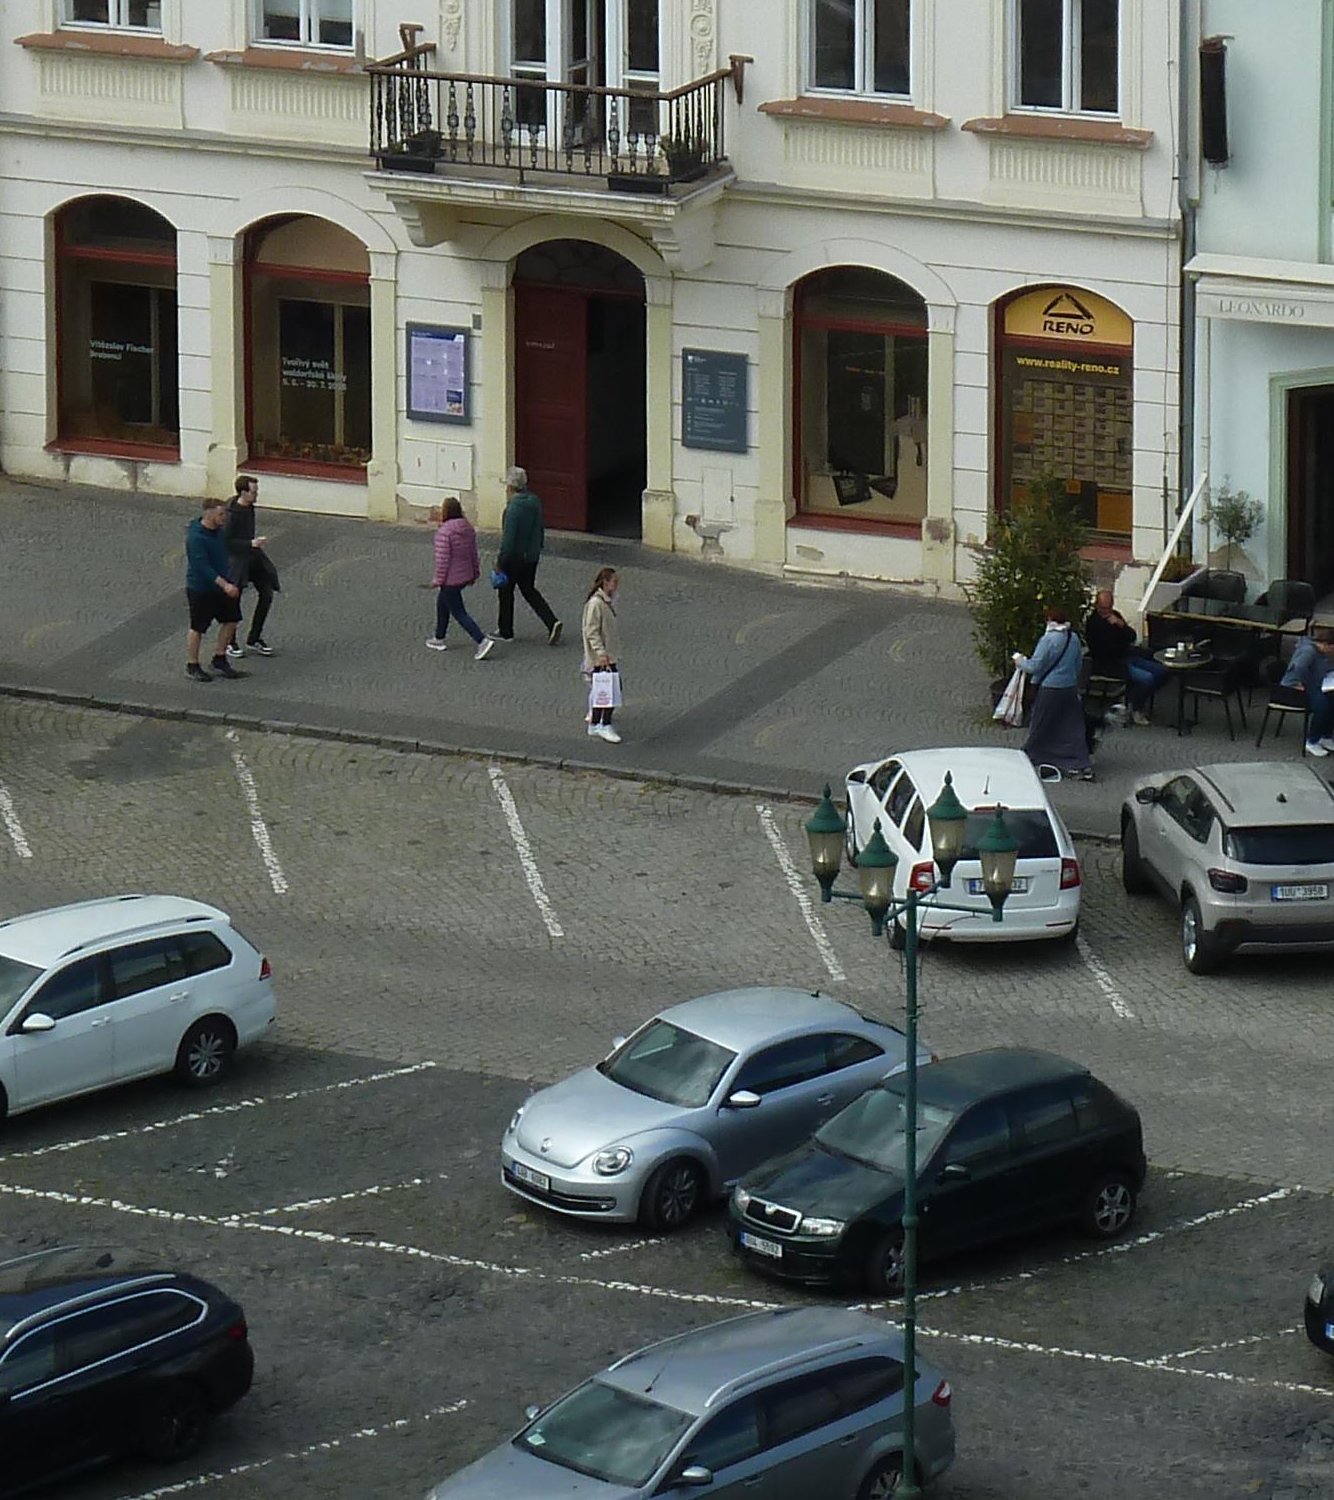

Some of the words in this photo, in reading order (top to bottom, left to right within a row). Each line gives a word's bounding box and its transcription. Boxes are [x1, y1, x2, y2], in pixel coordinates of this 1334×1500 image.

[1219, 299, 1305, 319] LEONARDO
[1042, 319, 1095, 336] RENO
[1015, 355, 1121, 376] www.reality-reno.cz
